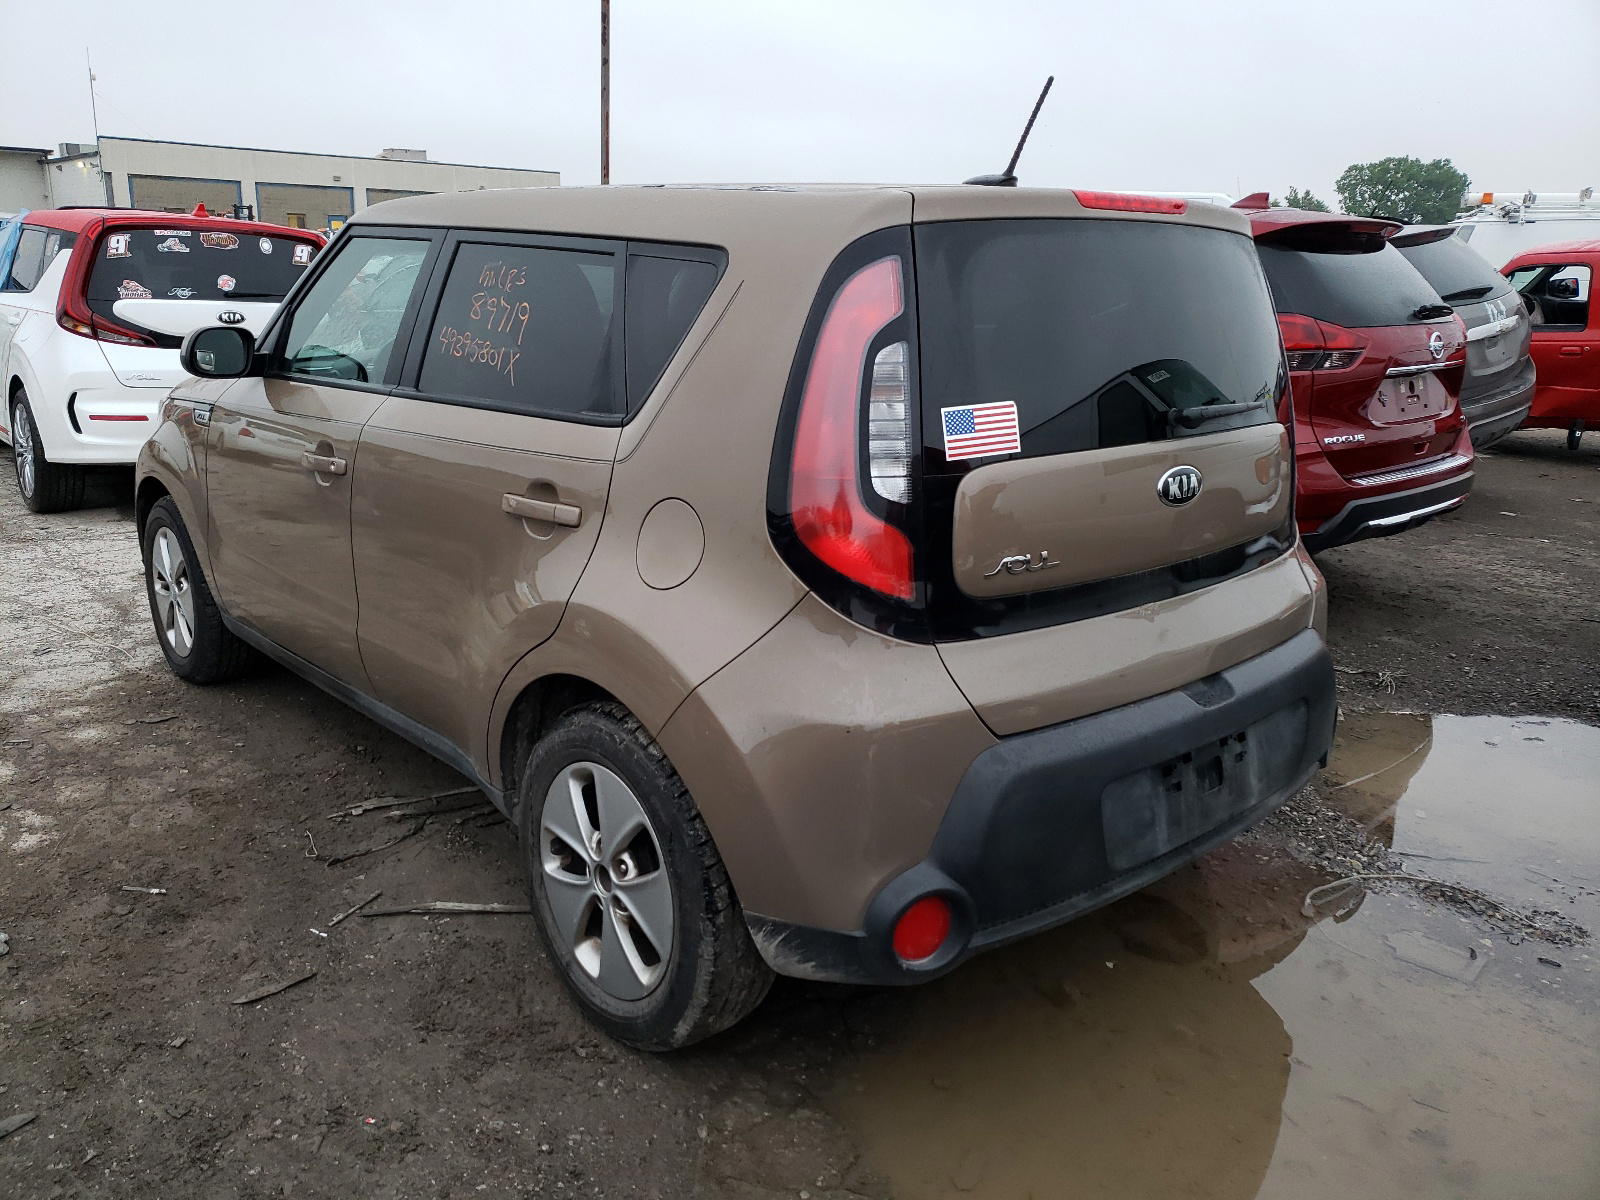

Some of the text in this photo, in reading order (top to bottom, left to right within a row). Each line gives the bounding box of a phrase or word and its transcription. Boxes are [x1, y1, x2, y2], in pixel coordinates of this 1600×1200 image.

[221, 313, 242, 322] KIA
[471, 291, 530, 345] 89719
[1323, 434, 1366, 444] ROGUE
[1168, 473, 1200, 500] KIA
